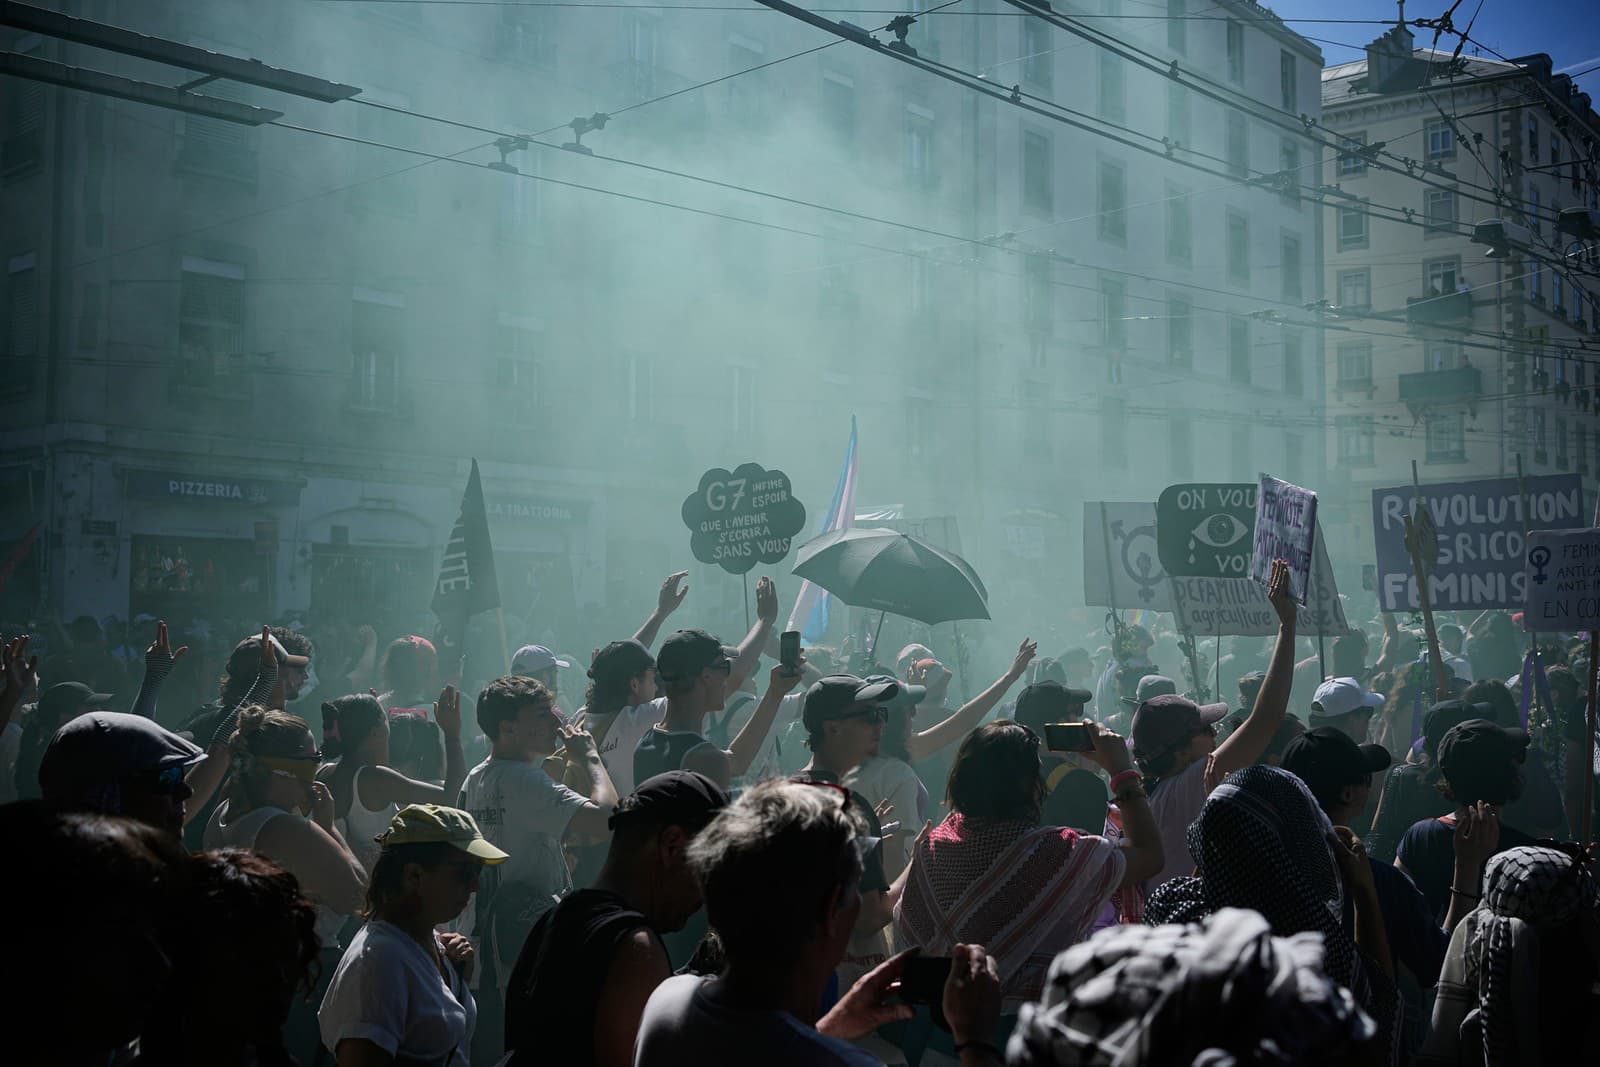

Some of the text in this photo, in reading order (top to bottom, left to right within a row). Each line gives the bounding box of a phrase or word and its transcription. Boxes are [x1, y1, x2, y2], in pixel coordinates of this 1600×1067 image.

[168, 480, 242, 499] PIZZERIA
[706, 479, 746, 511] G7
[752, 479, 784, 492] INFIME
[752, 491, 788, 508] ESPOIR
[1177, 489, 1206, 510] ON
[504, 504, 571, 520] TRATTORIA
[700, 513, 768, 532] QUE L'AVENIR
[712, 538, 790, 559] SANS VOUS
[1543, 599, 1569, 618] EN
